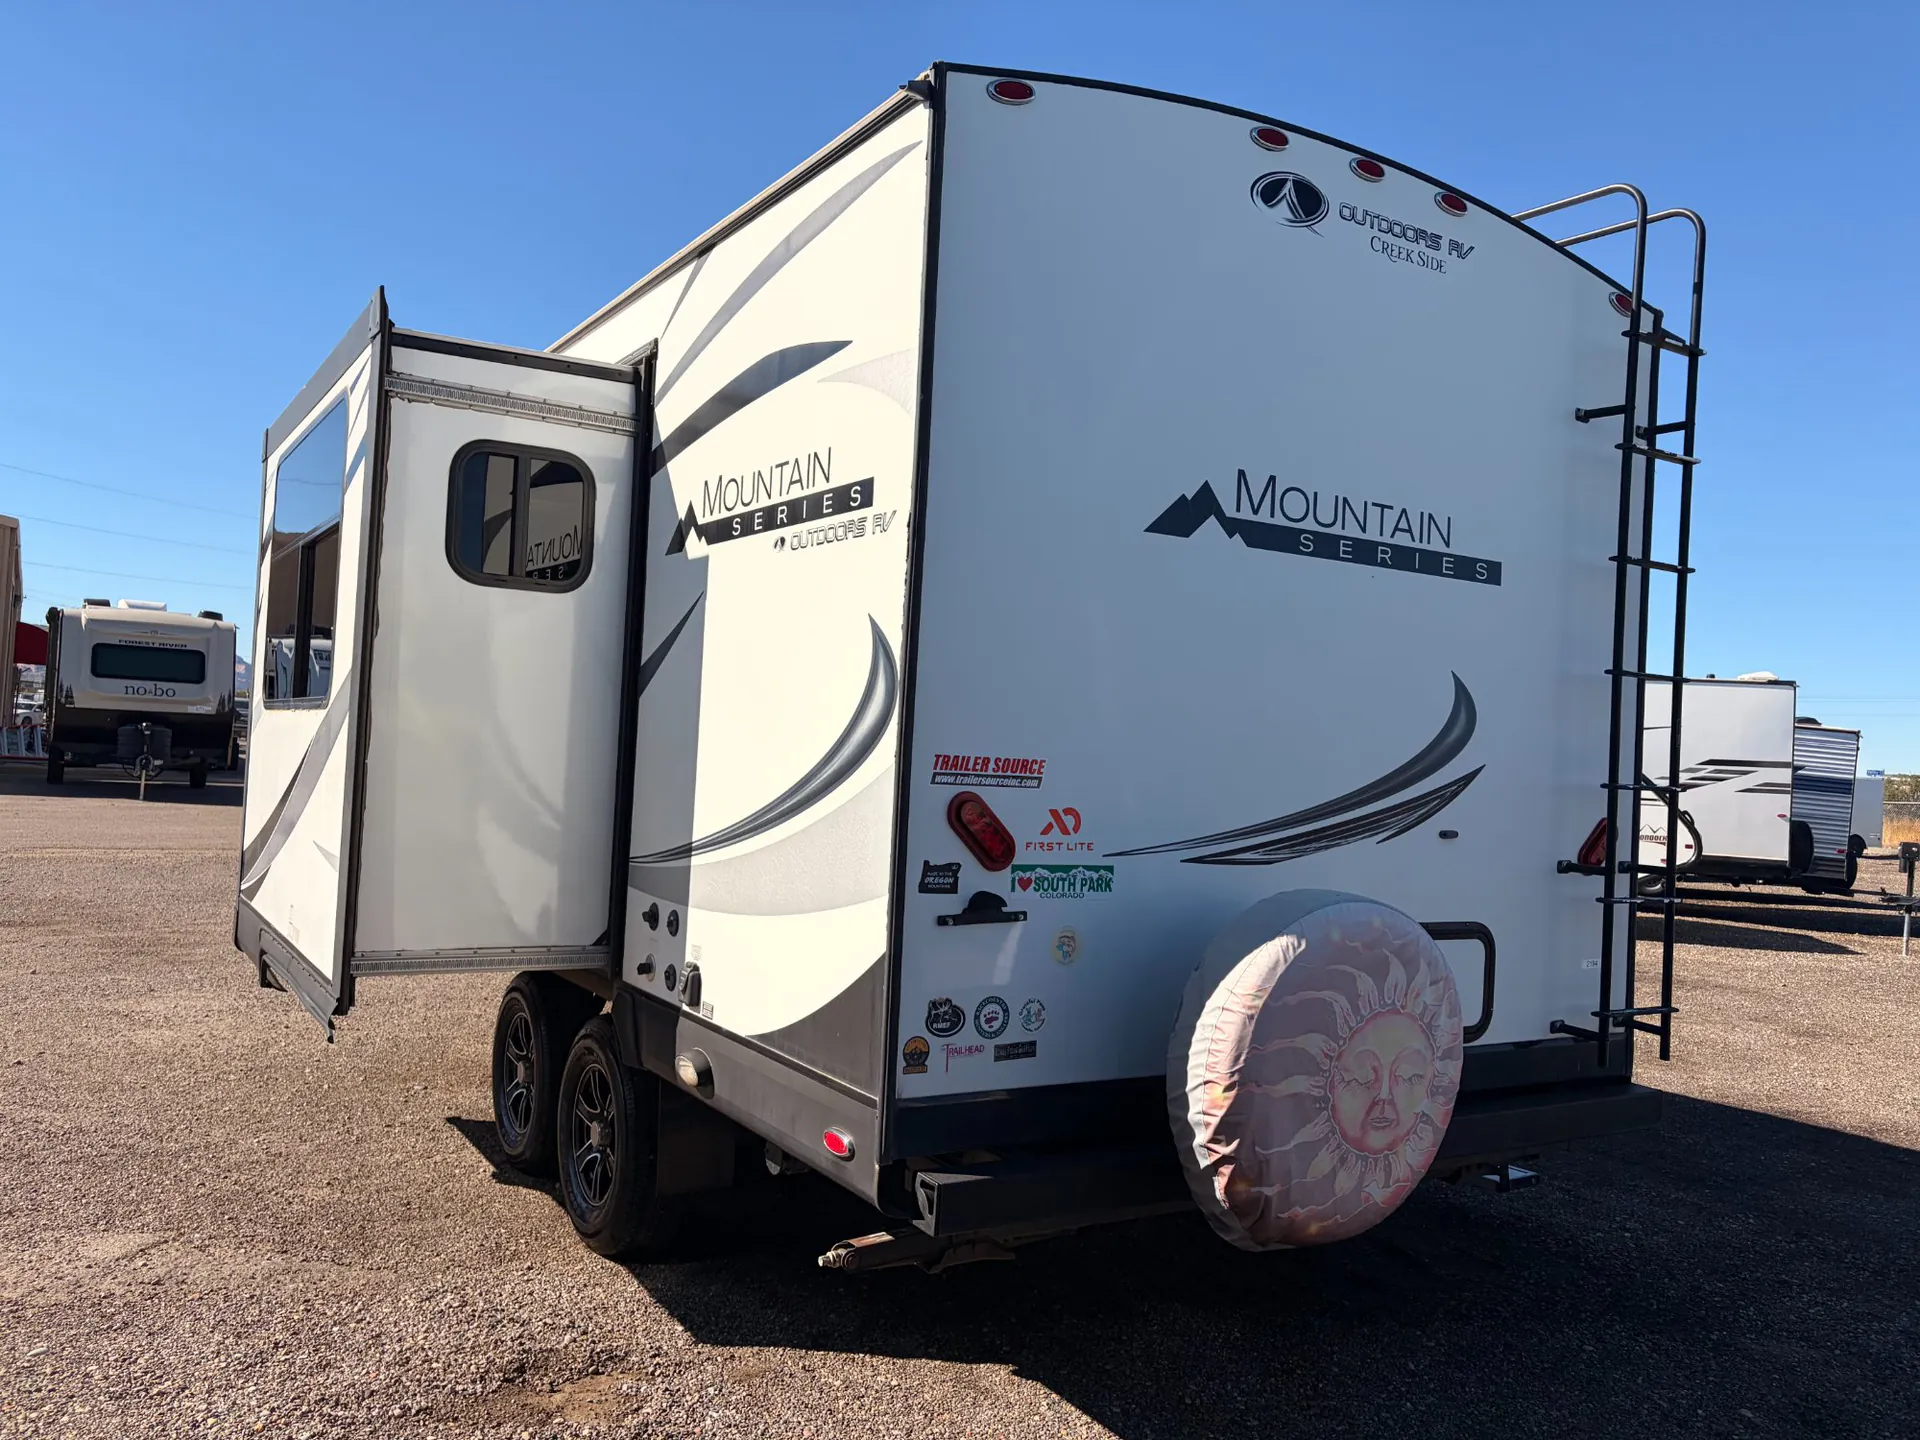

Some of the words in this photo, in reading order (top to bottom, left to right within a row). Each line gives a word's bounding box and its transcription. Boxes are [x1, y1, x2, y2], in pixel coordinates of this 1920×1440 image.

[1339, 202, 1442, 252] OUTDOORS
[1449, 238, 1475, 260] RV
[702, 446, 832, 519] MOUNTAIN
[732, 485, 862, 536] SERIES
[1235, 468, 1451, 549] MOUNTAIN
[790, 520, 867, 551] OUTDOORS
[872, 510, 897, 535] RV
[1299, 534, 1488, 580] SERIES
[933, 754, 991, 773] TRAILER
[992, 757, 1046, 775] SOURCE
[934, 774, 1039, 787] www.trailersourceinc.com
[1025, 842, 1063, 852] FIRST
[1067, 843, 1094, 851] LITE
[924, 876, 954, 884] OREGON
[1033, 876, 1074, 893] SOUTH
[1079, 877, 1113, 893] PARK
[1039, 892, 1085, 900] COLORADO
[942, 1044, 985, 1072] TRAILHEAD
